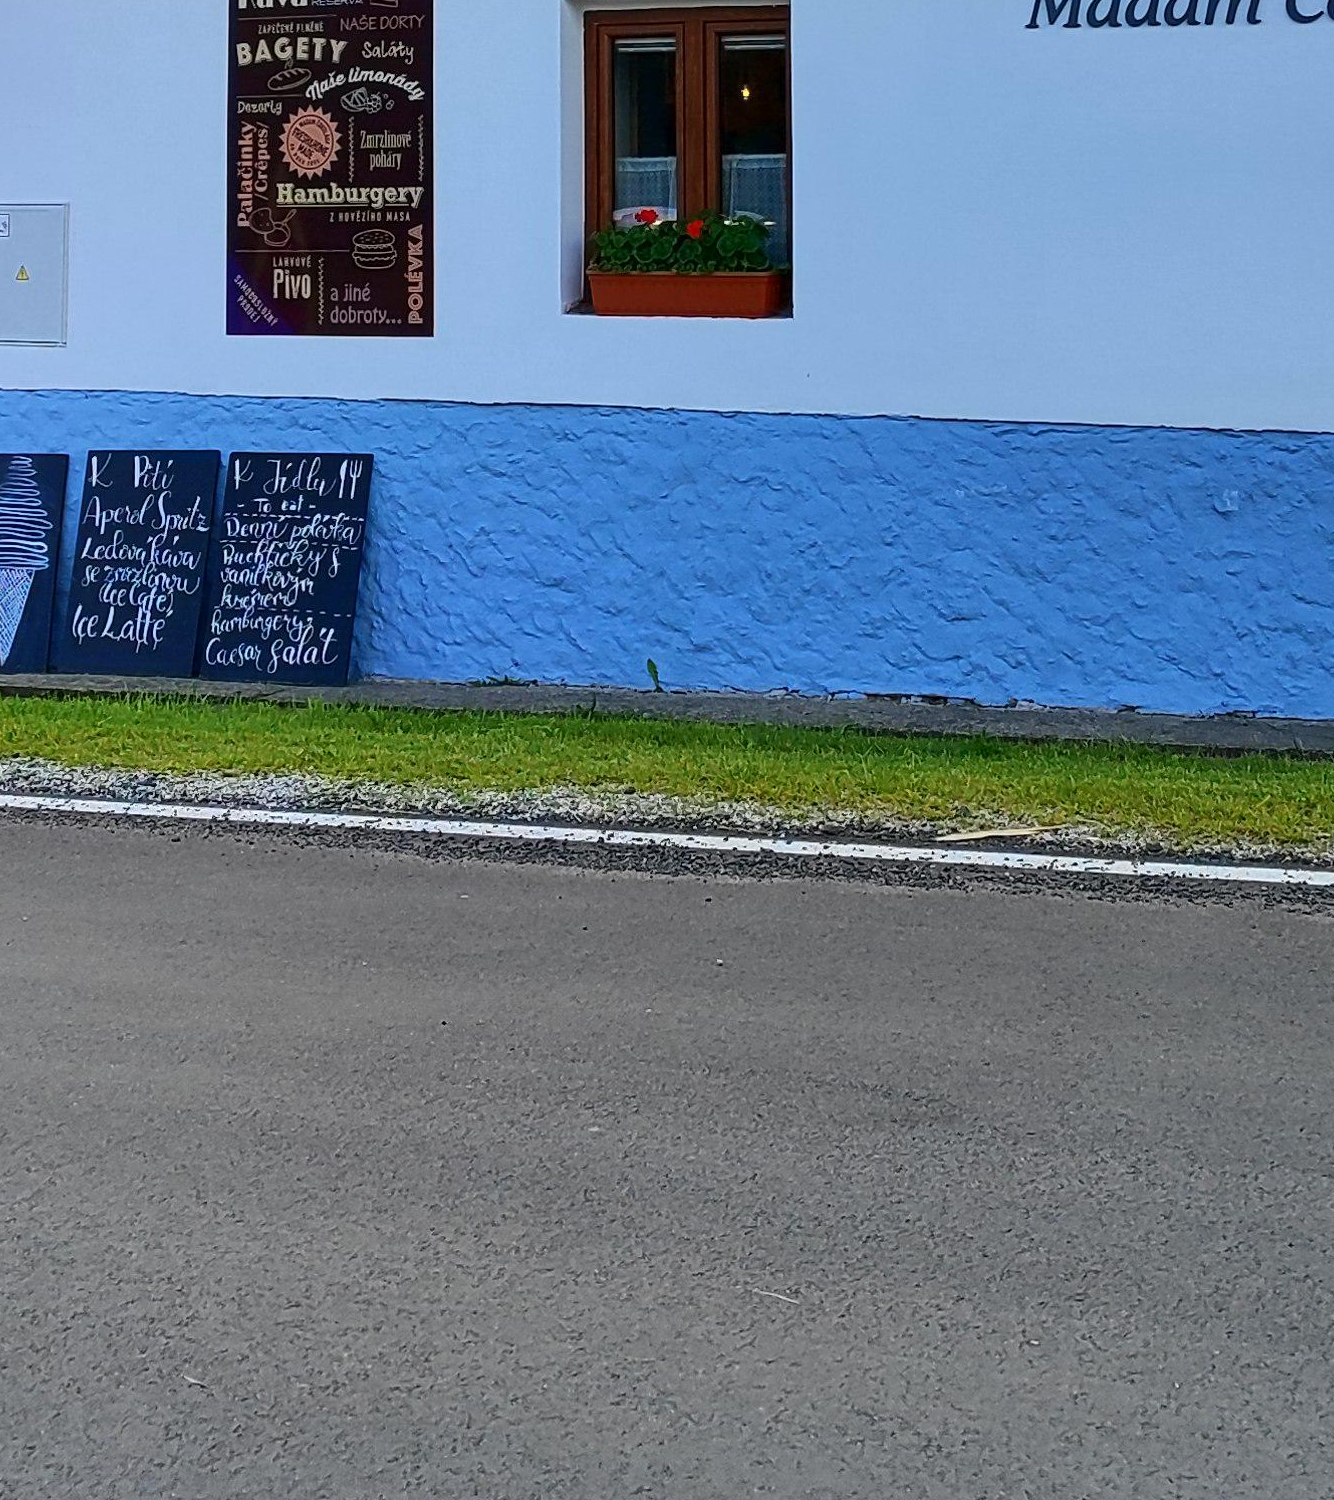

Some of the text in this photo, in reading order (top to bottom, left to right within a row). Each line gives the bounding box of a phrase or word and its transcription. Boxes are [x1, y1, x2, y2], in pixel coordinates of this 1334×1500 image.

[340, 14, 426, 31] NAŠE DORTY
[236, 36, 348, 66] BAGETY
[361, 40, 414, 65] Saláty
[305, 71, 346, 101] Naše
[360, 130, 412, 149] Zmrzlinové
[237, 120, 257, 227] Palačinky
[370, 150, 402, 171] poháry
[276, 182, 425, 208] Hamburgery
[386, 211, 411, 222] MASA
[273, 268, 311, 299] Pivo
[404, 224, 423, 324] POLÉVKA
[330, 282, 371, 302] a jiné
[88, 453, 113, 487] K
[234, 458, 254, 490] K
[82, 491, 210, 534] Aperol Spritz
[253, 495, 304, 513] To eat
[82, 565, 100, 586] se
[206, 638, 262, 671] Caesar
